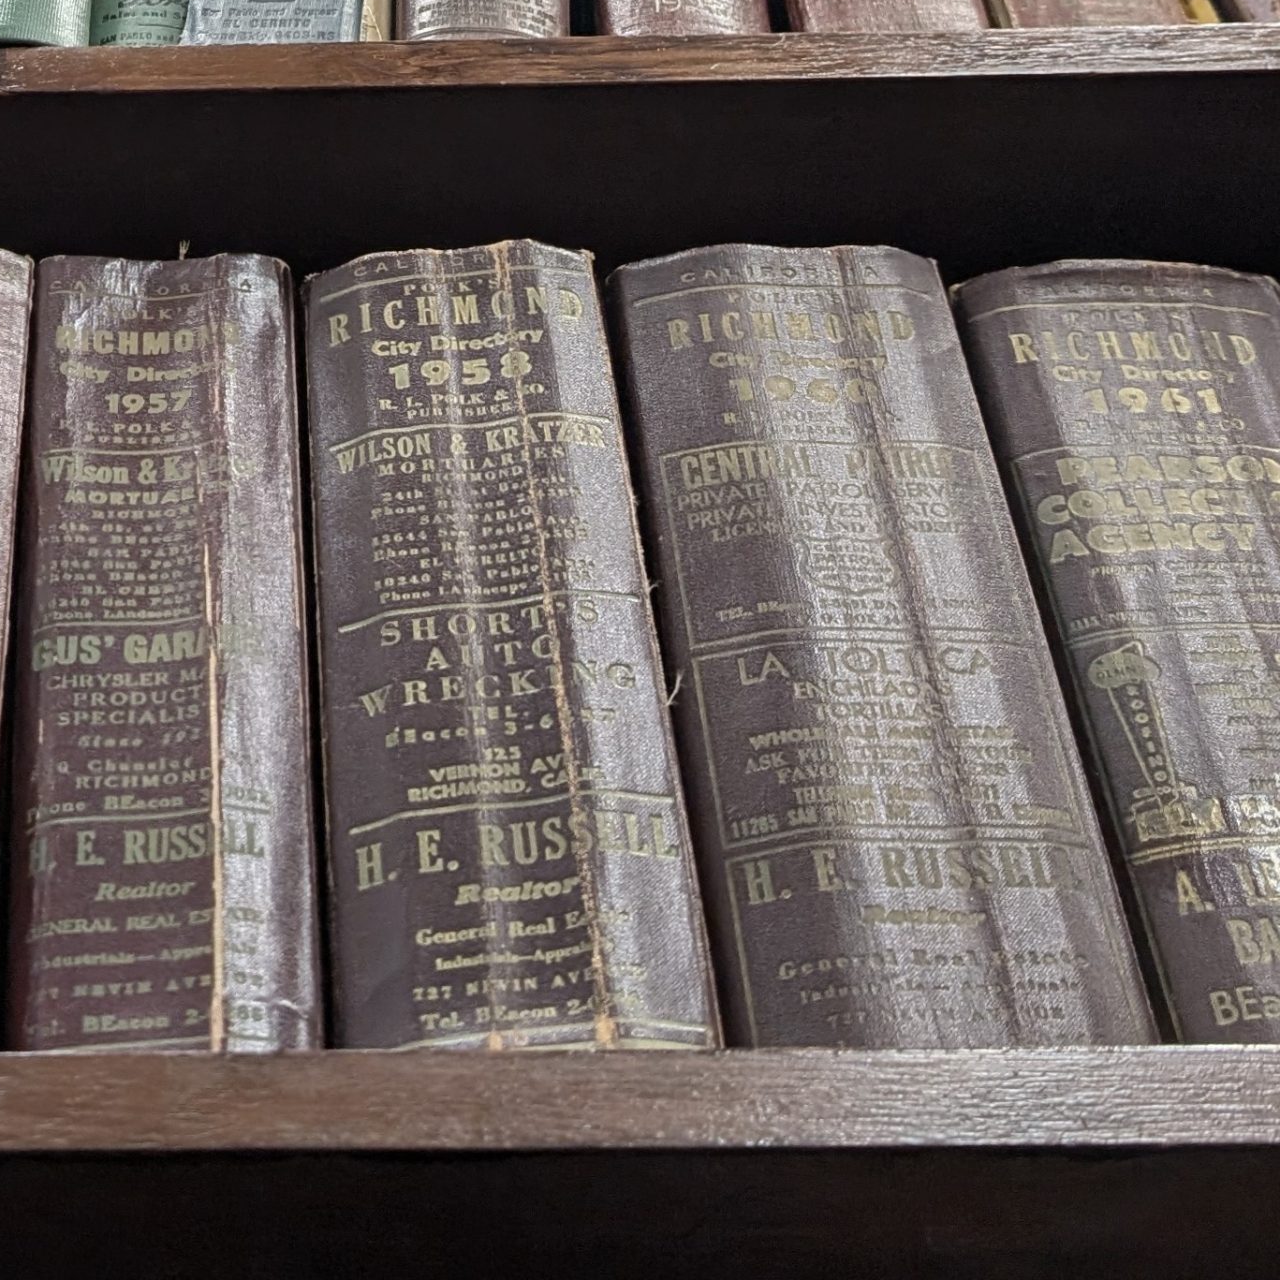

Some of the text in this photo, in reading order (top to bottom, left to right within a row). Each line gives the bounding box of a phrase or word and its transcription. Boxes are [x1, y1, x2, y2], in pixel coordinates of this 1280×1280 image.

[328, 286, 584, 347] RICHMOND
[667, 309, 916, 350] RICHMOND
[371, 328, 544, 357] City Directory
[1008, 331, 1258, 366] RICHMOND
[104, 389, 193, 414] 1957
[432, 393, 486, 407] POLK
[494, 389, 508, 402] &
[1085, 387, 1222, 414] 1961
[335, 433, 432, 474] WILSON
[451, 433, 469, 455] &
[139, 457, 158, 484] &
[1049, 522, 1256, 564] AGENCY
[47, 671, 170, 689] CHRYSLER
[737, 651, 790, 687] LA
[429, 761, 521, 783] VERNON
[76, 829, 106, 866] E.
[356, 810, 681, 892] H. E. RUSSELL
[95, 880, 196, 902] Realtor
[454, 875, 581, 906] Realtor
[742, 858, 794, 906] H.
[126, 914, 180, 931] REAL
[416, 926, 498, 947] General
